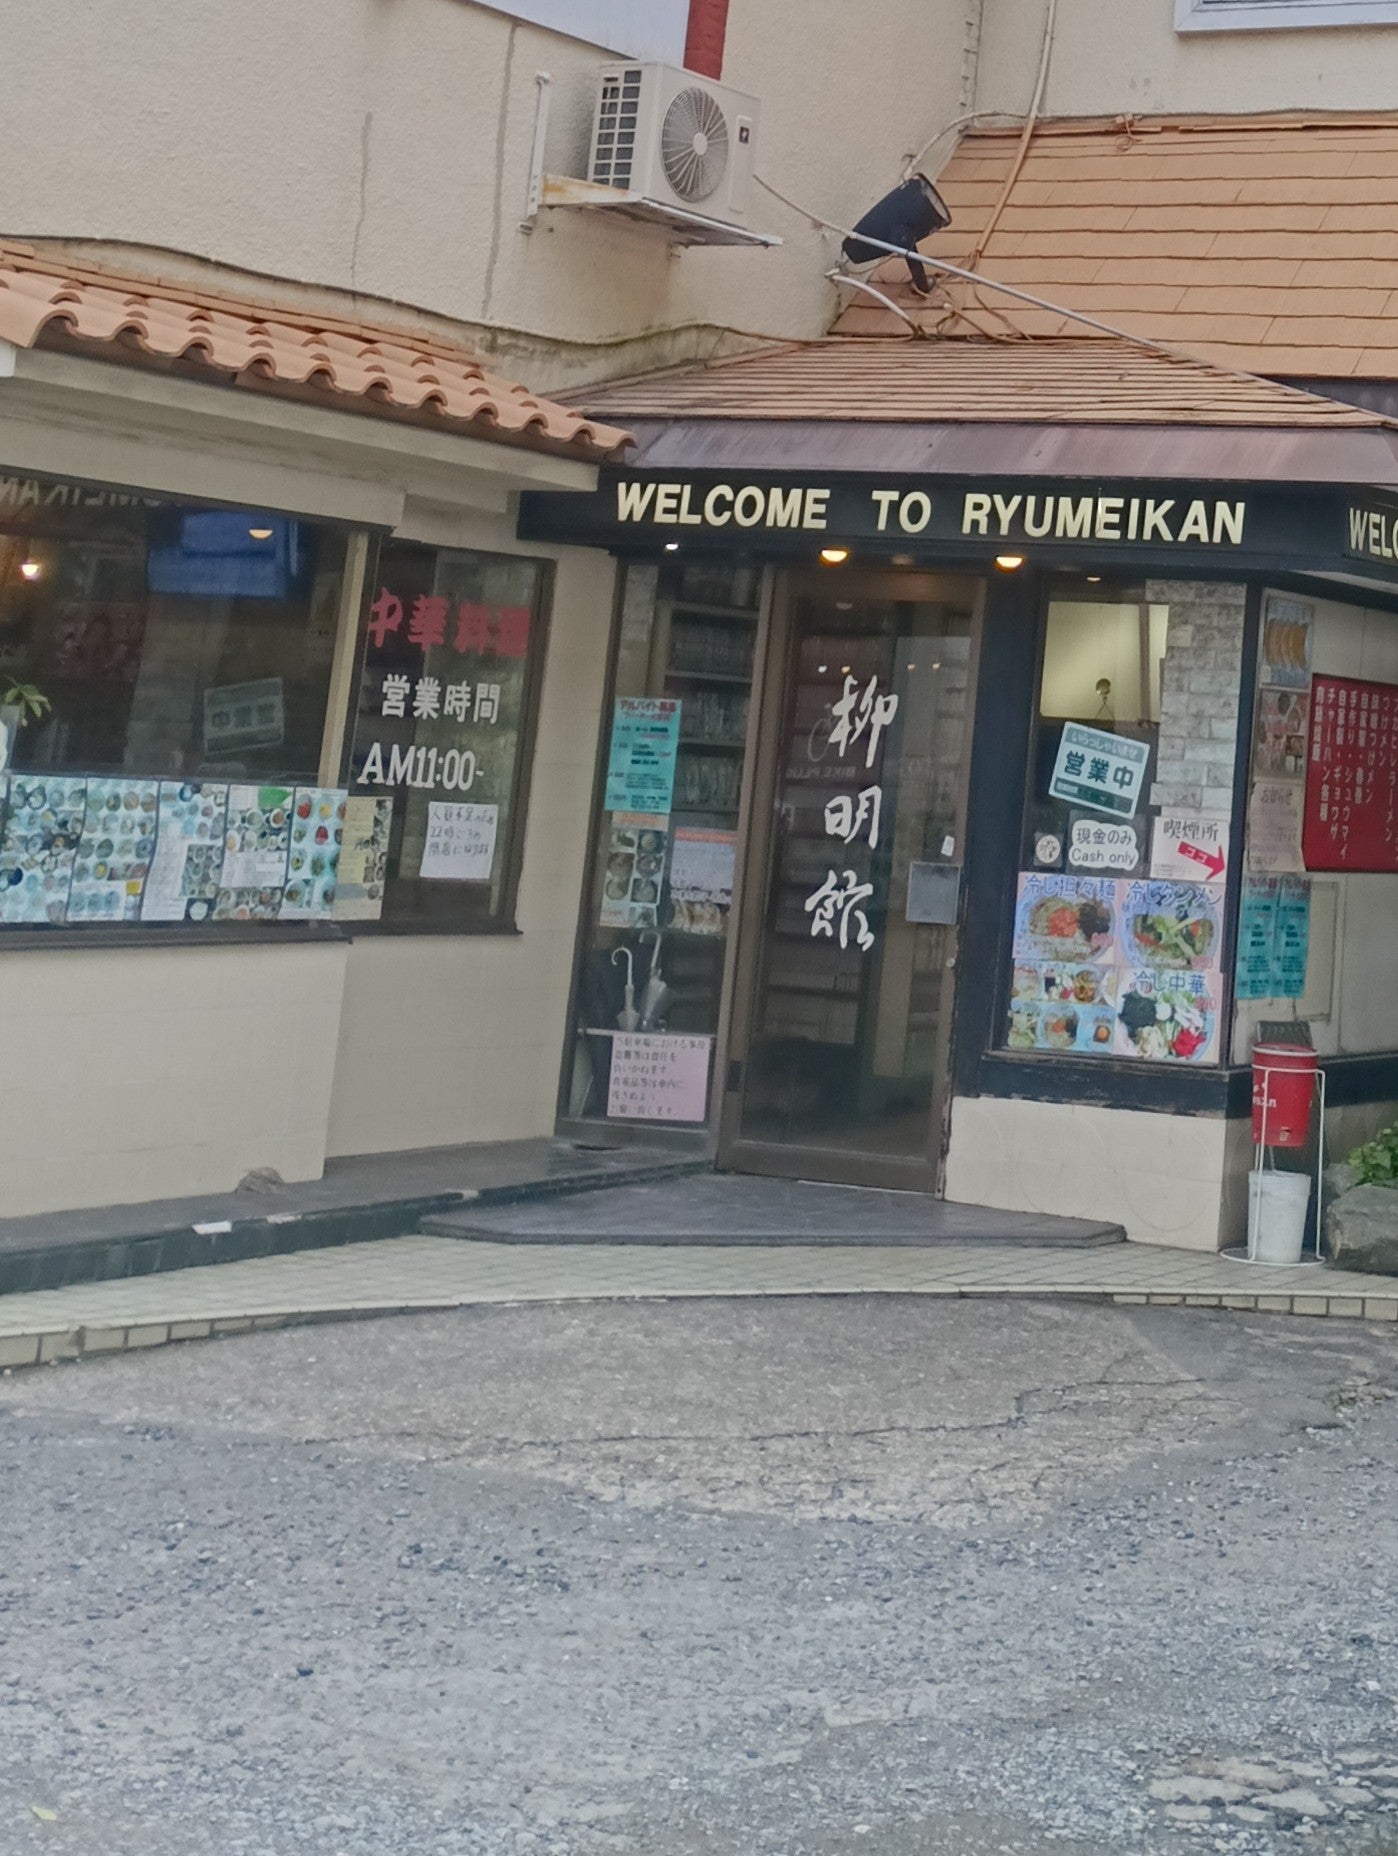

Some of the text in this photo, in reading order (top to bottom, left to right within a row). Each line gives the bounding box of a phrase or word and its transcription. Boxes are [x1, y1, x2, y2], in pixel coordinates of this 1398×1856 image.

[617, 481, 1246, 544] WELCOME TO RYUMEIKAN
[381, 673, 500, 724] 営業時間
[1064, 750, 1134, 790] 営業中
[1077, 827, 1132, 845] 現金のみ
[1163, 819, 1219, 842] 喫煙所
[1071, 847, 1136, 864] Cash only
[1133, 971, 1205, 994] 冷し中華
